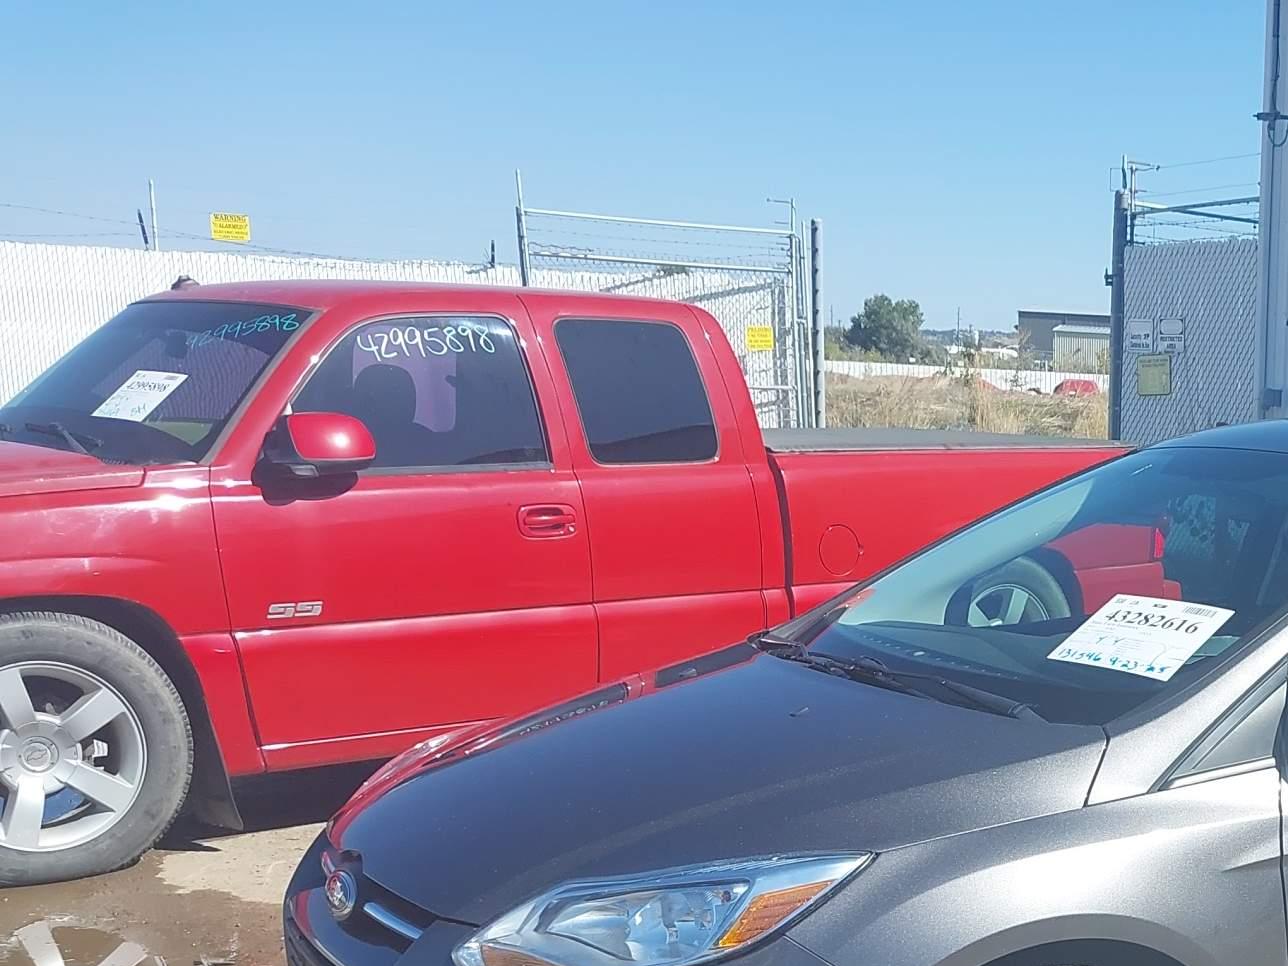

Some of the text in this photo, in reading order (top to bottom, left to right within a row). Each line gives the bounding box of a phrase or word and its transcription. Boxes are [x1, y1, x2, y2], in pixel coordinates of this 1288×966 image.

[213, 213, 248, 222] WARNING
[186, 313, 300, 349] 42995898
[357, 326, 495, 361] 42995898
[266, 600, 323, 619] SS
[1105, 609, 1205, 634] 43282616
